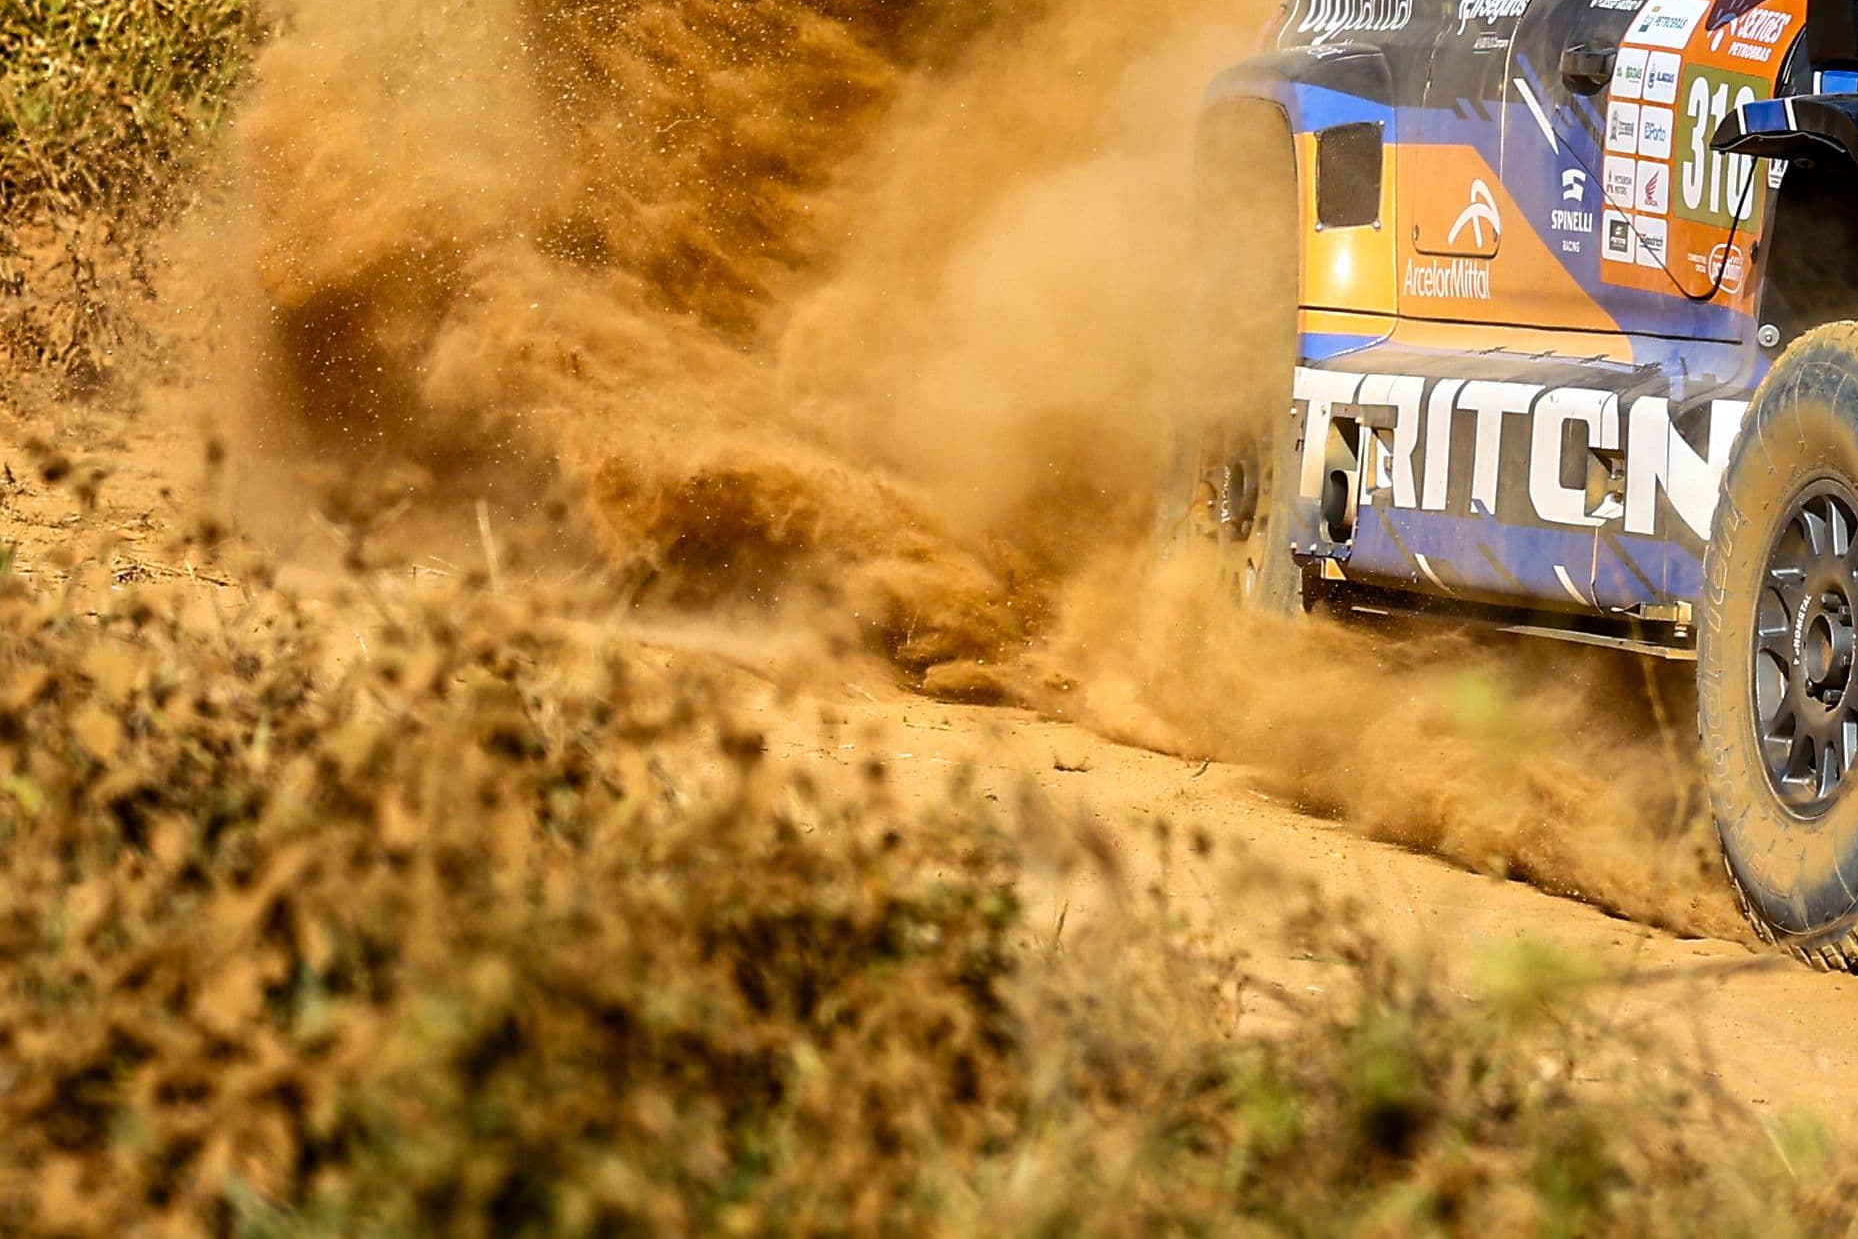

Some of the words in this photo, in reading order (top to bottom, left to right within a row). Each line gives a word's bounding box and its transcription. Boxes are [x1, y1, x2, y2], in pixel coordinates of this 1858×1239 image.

[1727, 41, 1772, 62] PETROBRAS
[1682, 77, 1757, 221] 310
[1551, 210, 1593, 233] SPINELLI
[1403, 259, 1491, 300] ArcelorMittal
[1292, 365, 1752, 540] TRITON
